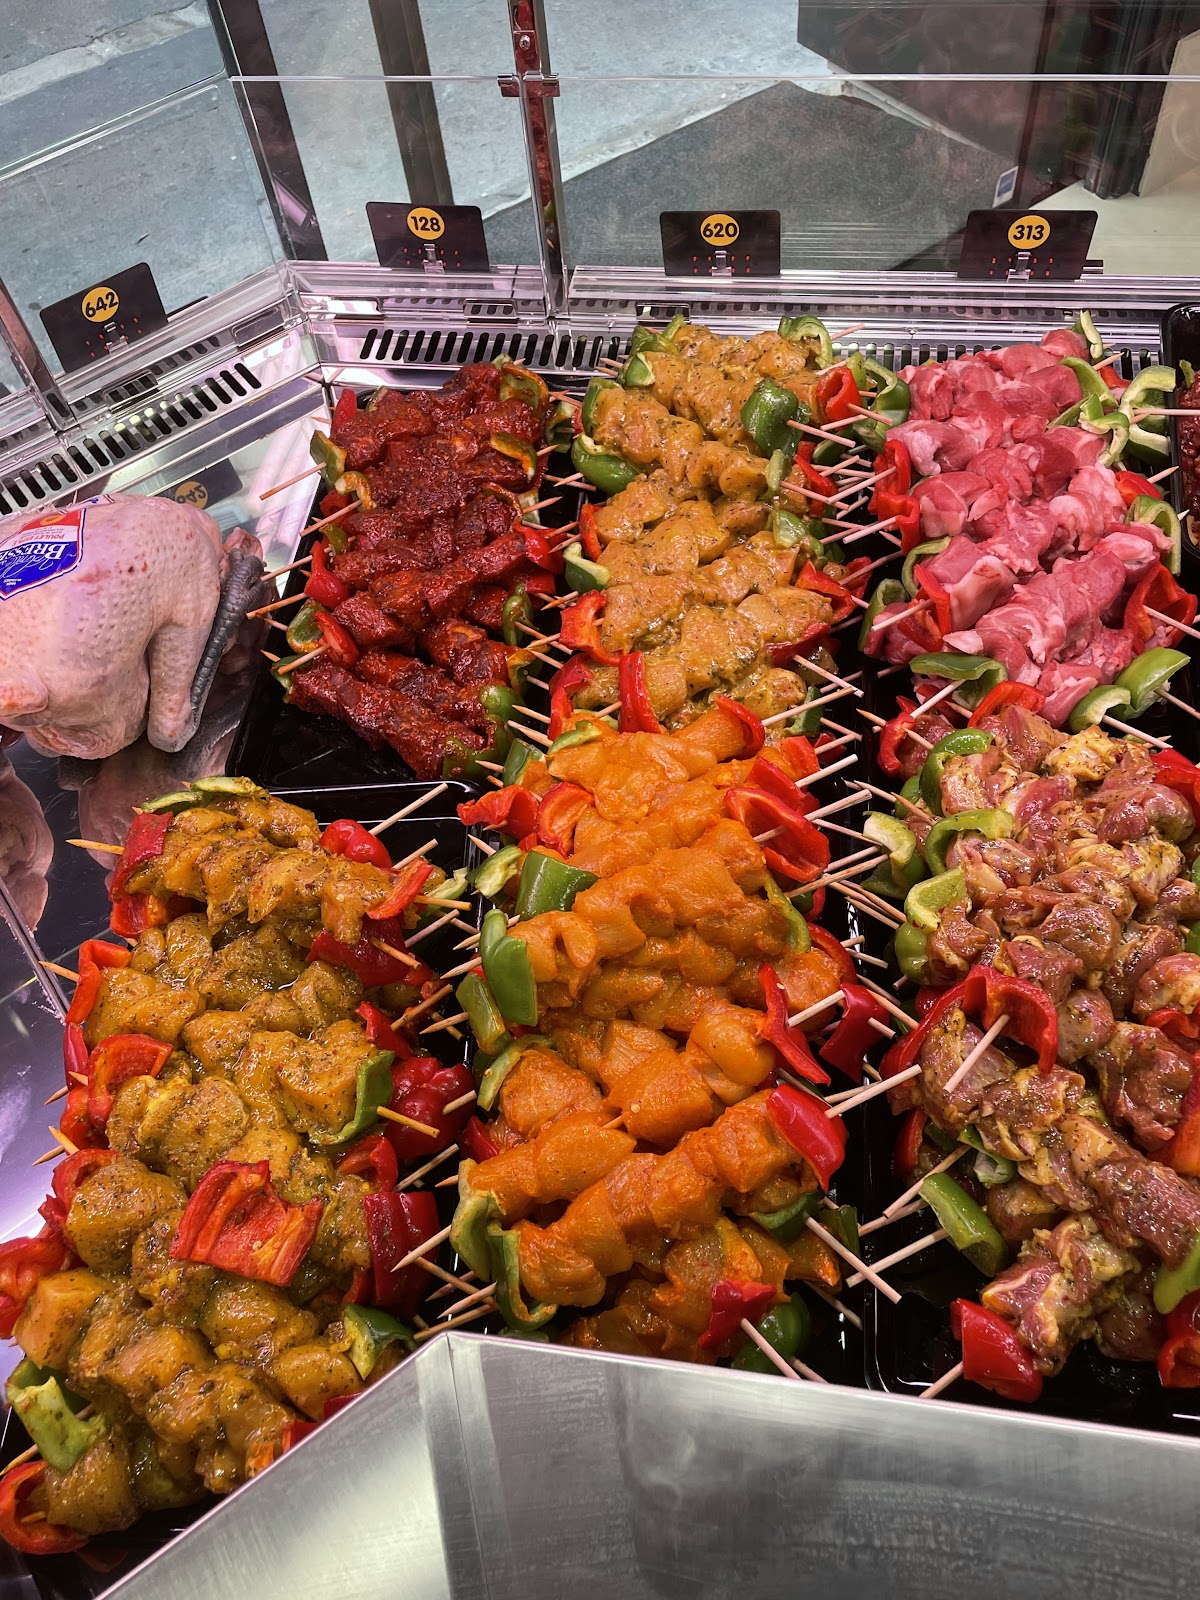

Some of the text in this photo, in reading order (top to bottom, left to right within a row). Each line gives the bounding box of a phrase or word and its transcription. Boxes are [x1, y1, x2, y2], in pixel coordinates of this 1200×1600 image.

[410, 216, 441, 233] 128
[702, 222, 738, 238] 620
[1012, 224, 1045, 241] 313
[85, 291, 119, 318] 642
[35, 533, 65, 541] POULET
